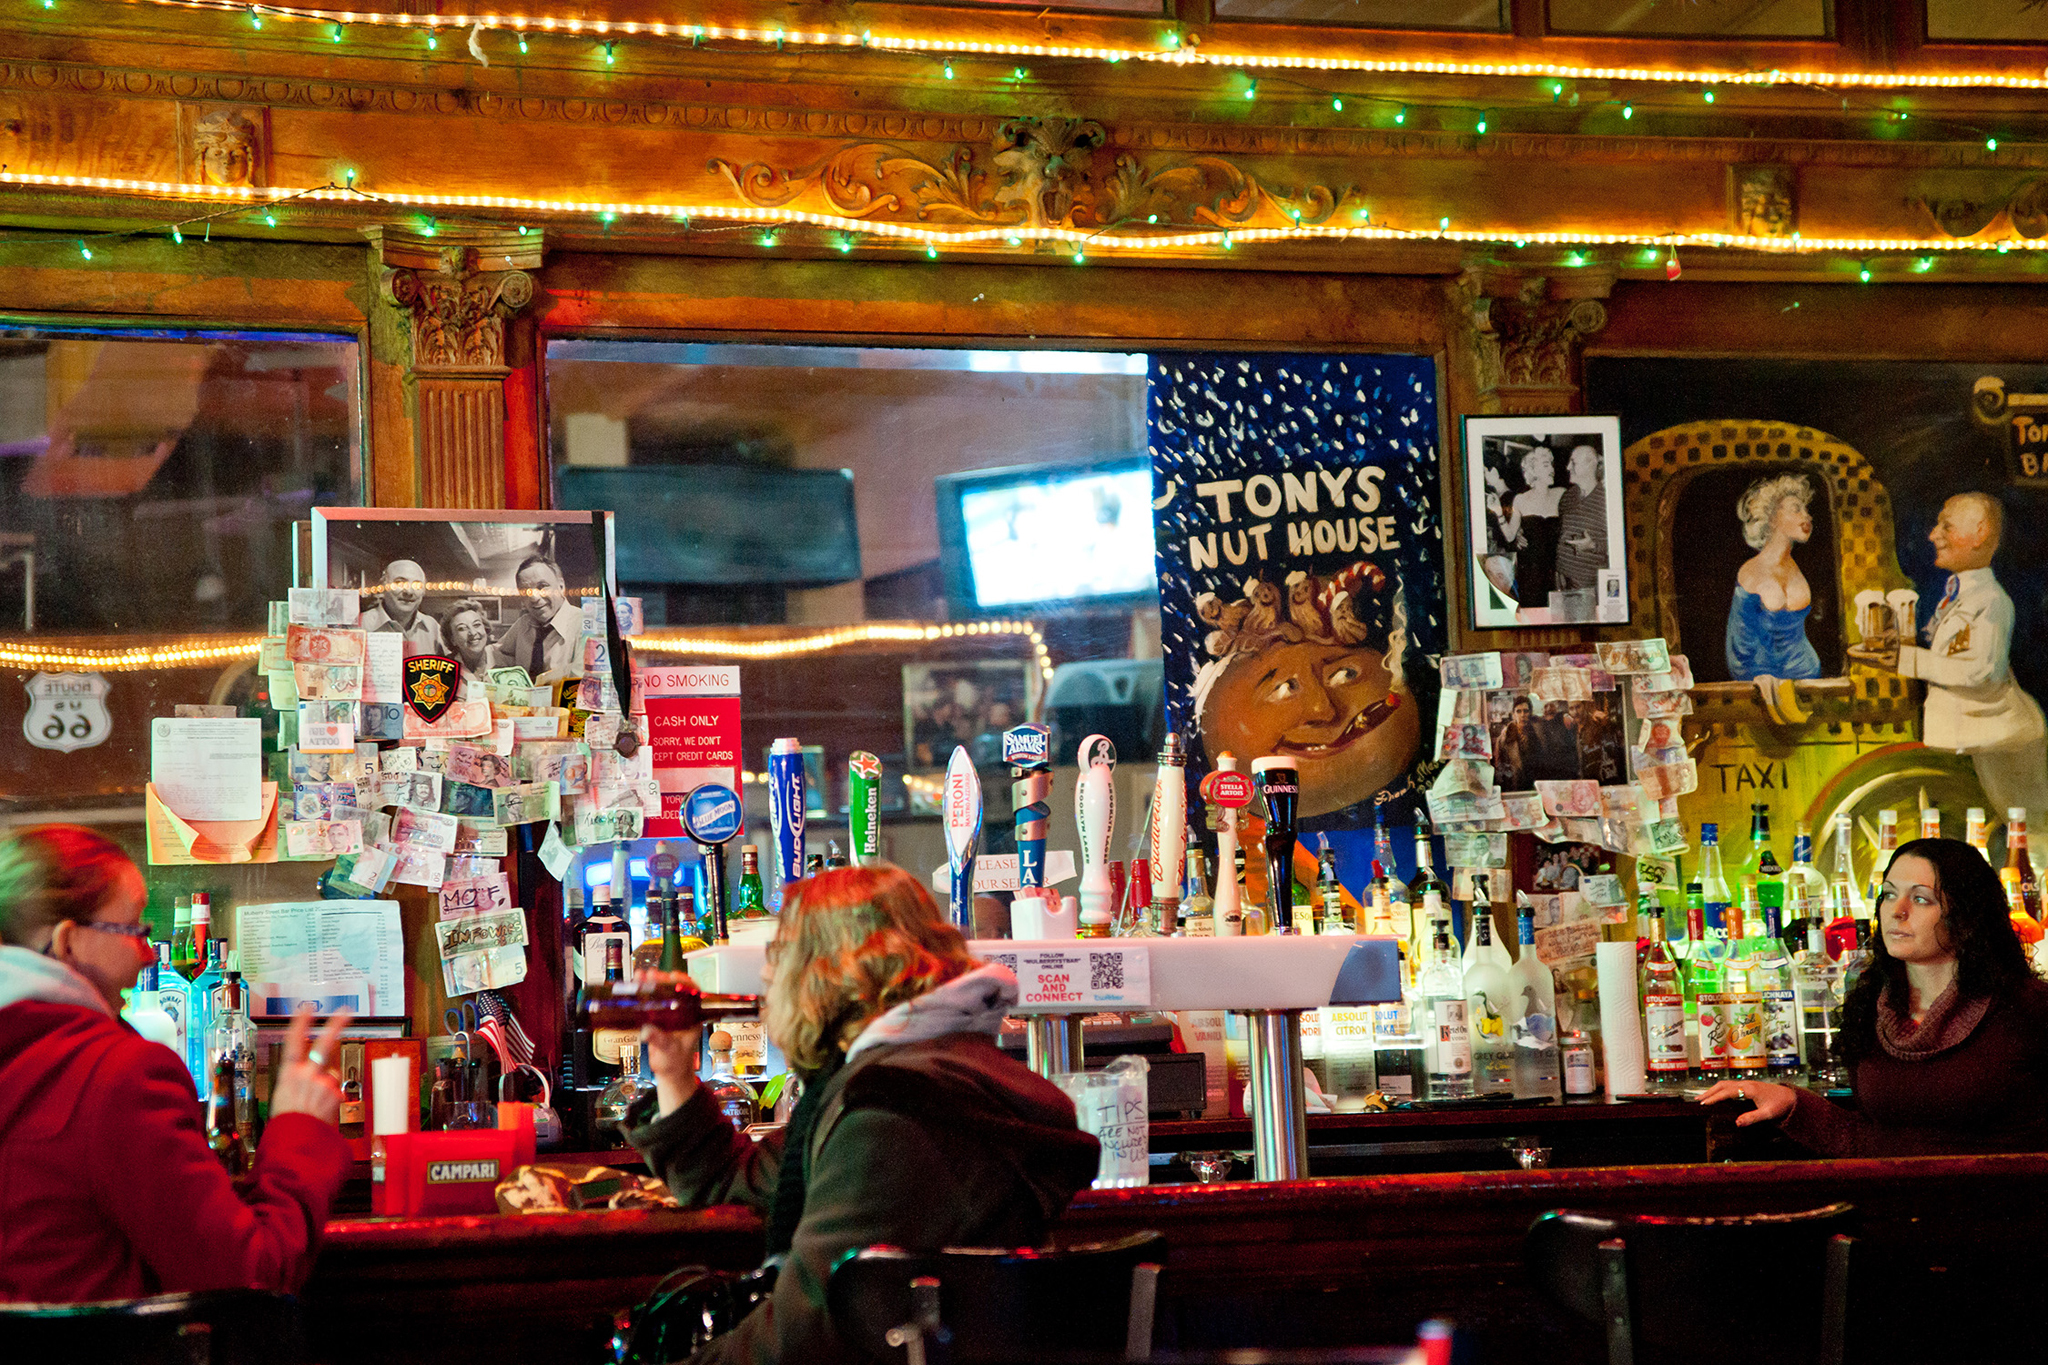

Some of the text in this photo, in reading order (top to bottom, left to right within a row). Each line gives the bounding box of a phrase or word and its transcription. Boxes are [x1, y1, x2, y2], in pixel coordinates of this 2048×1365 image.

[1196, 466, 1386, 523] TONYS
[1189, 516, 1400, 572] NUT HOUSE
[407, 659, 455, 674] SHERIFF
[667, 673, 730, 687] SMOKING
[654, 715, 719, 727] CASH ONLY
[653, 735, 721, 747] SORRY, WE DON'T
[1005, 733, 1046, 746] SAMUEL
[1008, 742, 1044, 755] ADAMS
[652, 751, 734, 761] CEPT CREDIT CARDS
[1710, 761, 1789, 794] TAXI
[1263, 784, 1298, 794] GUINNESS
[951, 773, 964, 828] PERONI
[693, 802, 734, 828] BLUE MOON
[864, 786, 878, 854] Heineken
[791, 773, 802, 878] BUD LIGHT
[1151, 778, 1164, 883] Budweiser
[973, 879, 1000, 891] OUR
[1037, 974, 1070, 983] SCAN
[1042, 984, 1067, 992] AND
[1026, 992, 1083, 1002] CONNECT
[1332, 1011, 1368, 1022] ABSOLUT
[1335, 1024, 1367, 1036] CITRON
[1098, 1127, 1123, 1139] ARE
[431, 1163, 496, 1181] CAMPARI
